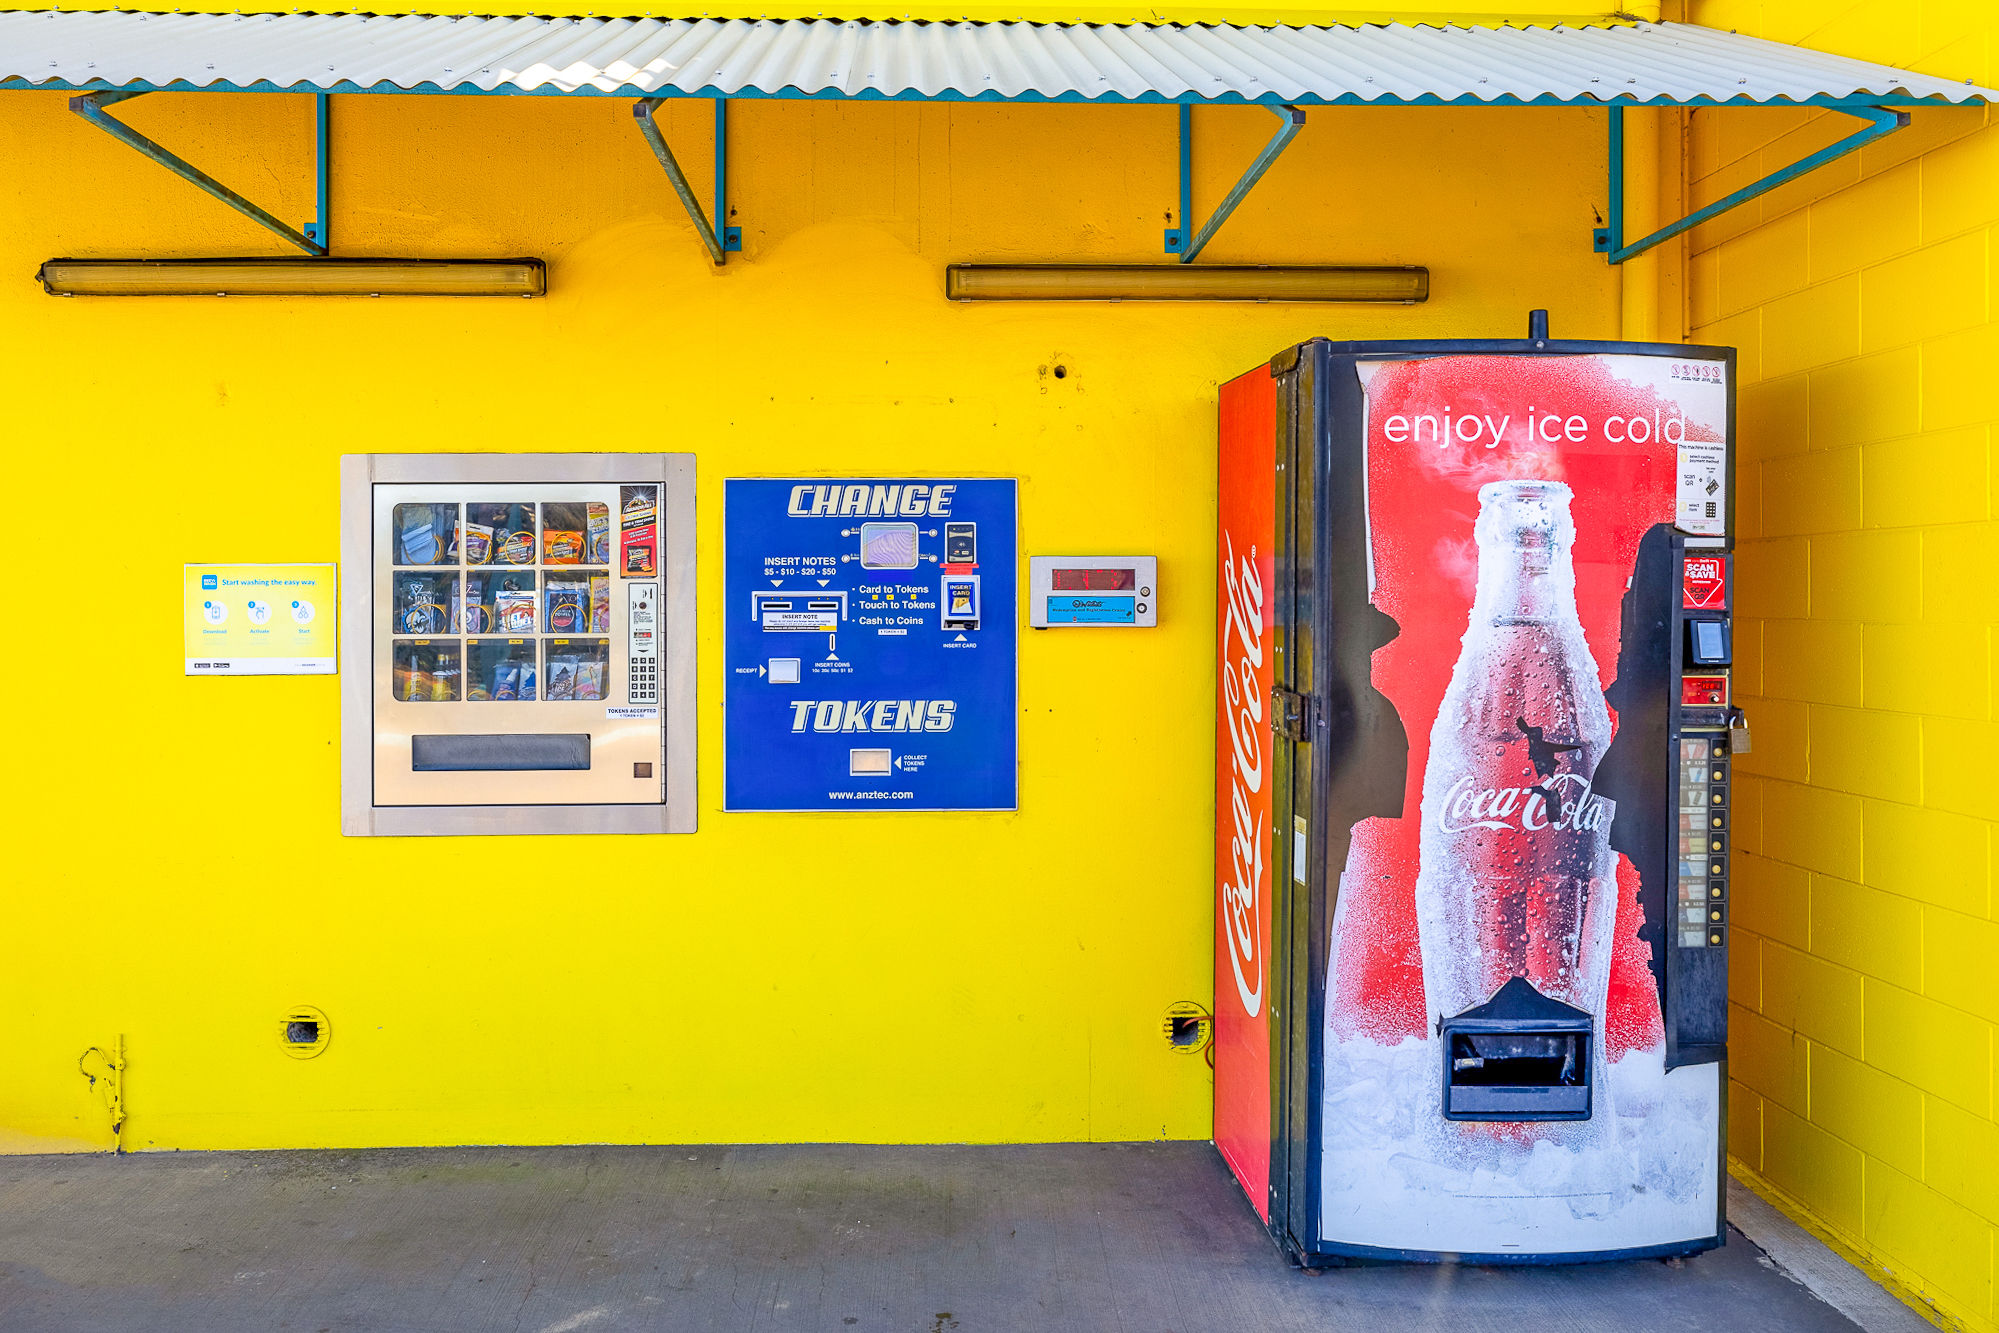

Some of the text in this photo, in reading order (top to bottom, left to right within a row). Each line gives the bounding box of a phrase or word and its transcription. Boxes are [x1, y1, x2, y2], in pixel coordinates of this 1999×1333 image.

[1384, 406, 1686, 448] enjoy ice cold
[787, 484, 957, 518] CHANGE
[764, 557, 836, 566] INSERT NOTES
[764, 568, 775, 576] $5
[781, 568, 794, 576] $10
[801, 568, 815, 576] $20
[822, 568, 836, 576] $50
[859, 585, 881, 593] Card
[895, 585, 929, 593] Tokens
[859, 601, 888, 609] Touch
[902, 601, 936, 609] Tokens
[859, 617, 882, 625] Cash
[896, 617, 923, 625] Coins
[790, 700, 957, 734] TOKENS
[1224, 528, 1264, 1018] Coca-Cola
[828, 791, 913, 800] www.anztec.com
[1440, 774, 1602, 834] Coca-Cola
